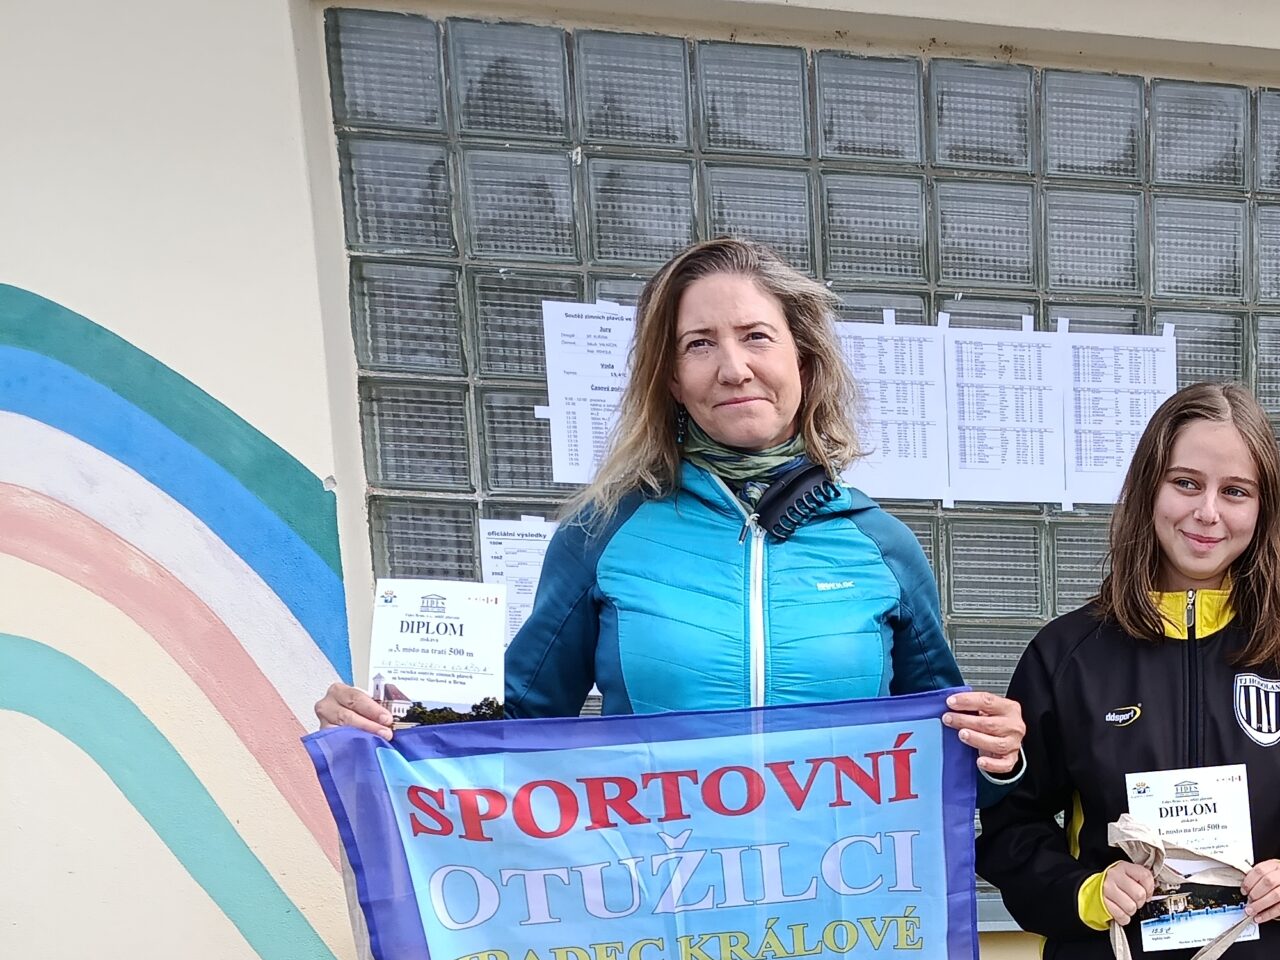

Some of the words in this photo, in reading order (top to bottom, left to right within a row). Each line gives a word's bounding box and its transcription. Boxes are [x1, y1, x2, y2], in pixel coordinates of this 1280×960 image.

[399, 620, 465, 637] DIPLOM
[448, 647, 465, 657] 500
[408, 731, 919, 842] SPORTOVNÍ
[1158, 802, 1218, 819] DIPLOM
[1206, 823, 1221, 832] 500
[428, 828, 923, 932] OTUŽILCI
